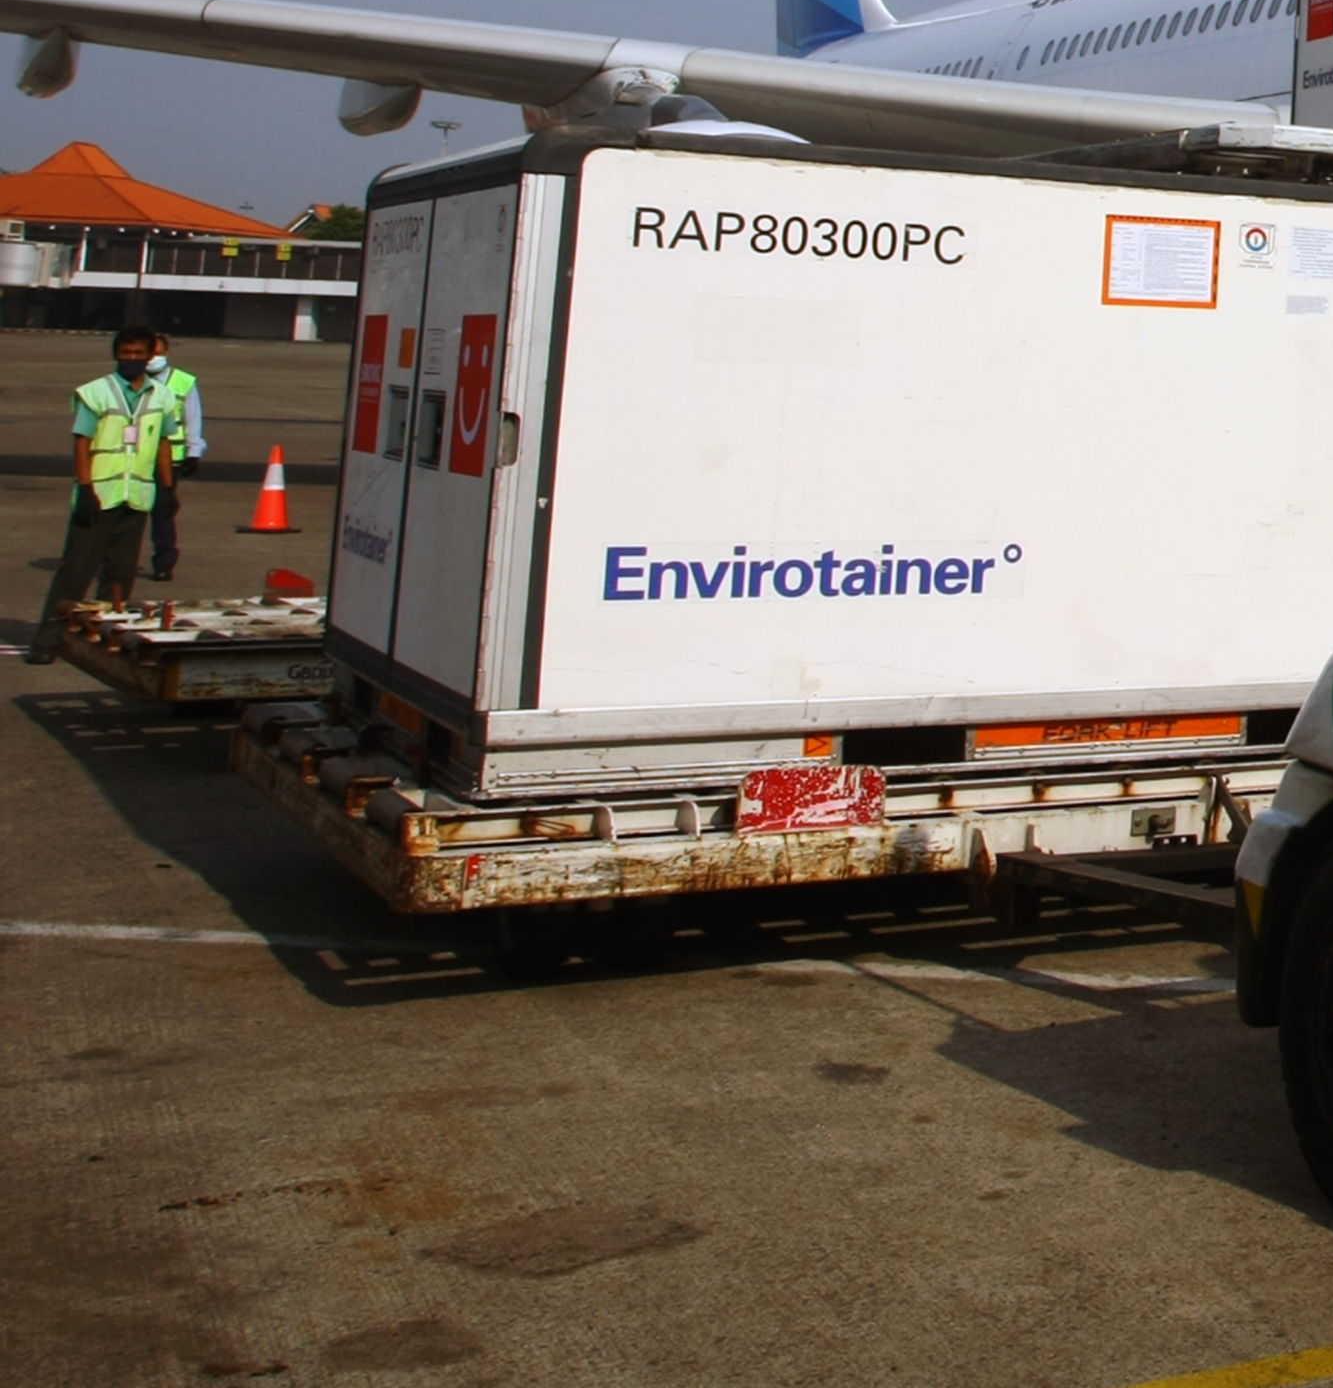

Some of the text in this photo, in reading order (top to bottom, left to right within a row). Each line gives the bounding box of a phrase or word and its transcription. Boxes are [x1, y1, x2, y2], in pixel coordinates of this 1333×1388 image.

[630, 206, 967, 266] RAP80300PC
[602, 544, 996, 602] Envirotainer
[1042, 719, 1181, 743] FORK LIFT
